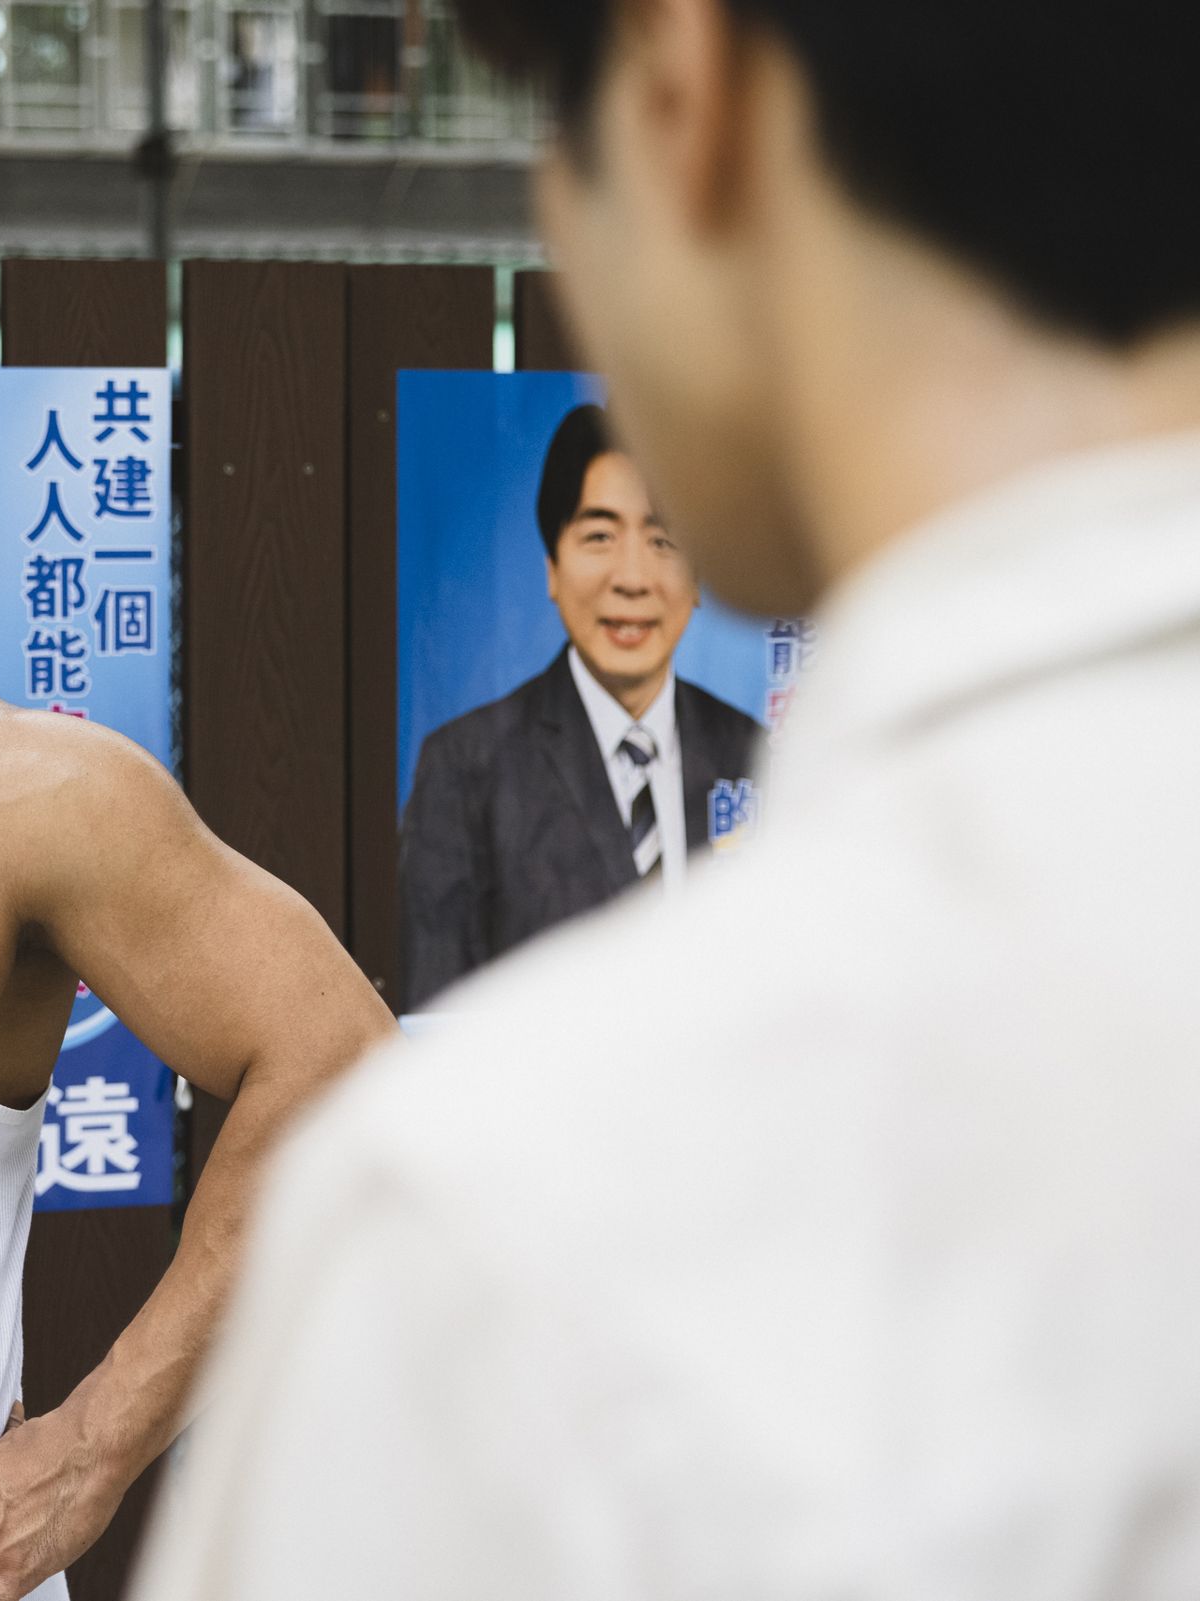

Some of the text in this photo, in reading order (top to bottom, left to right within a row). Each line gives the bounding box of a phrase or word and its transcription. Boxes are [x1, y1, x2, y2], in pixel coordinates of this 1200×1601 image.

[25, 409, 87, 720] 人人都能
[92, 379, 154, 653] 共建一個
